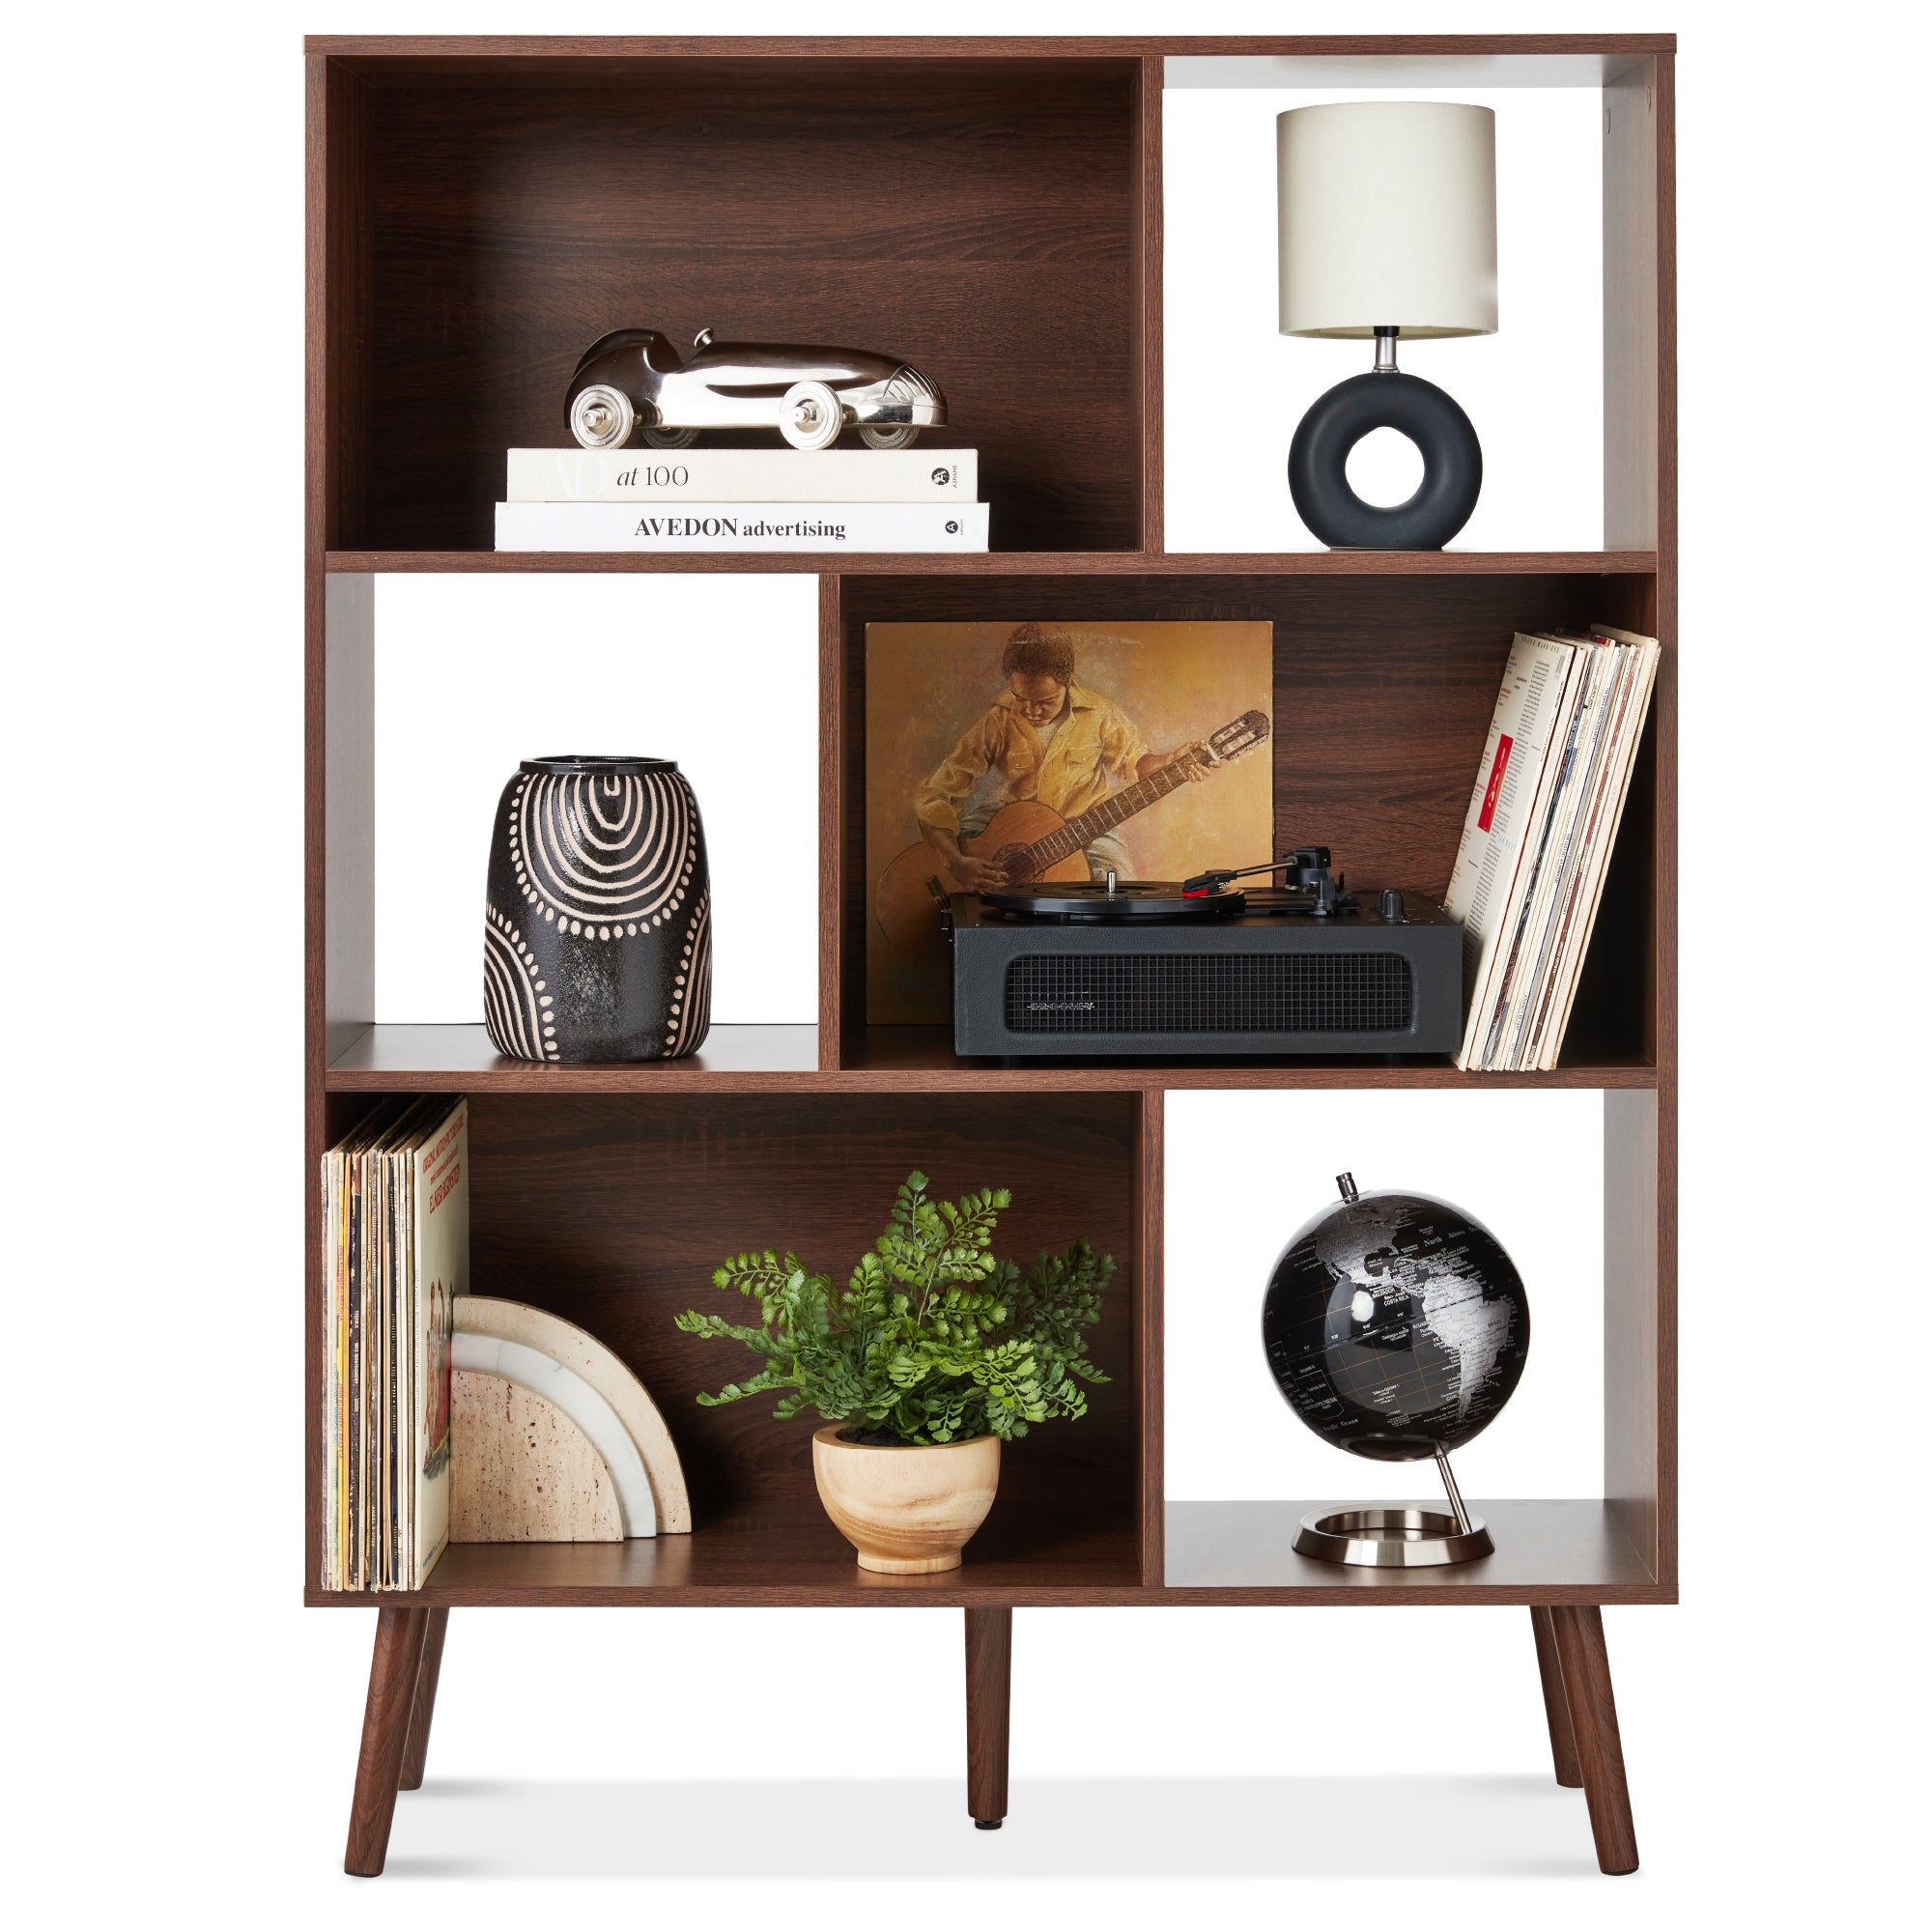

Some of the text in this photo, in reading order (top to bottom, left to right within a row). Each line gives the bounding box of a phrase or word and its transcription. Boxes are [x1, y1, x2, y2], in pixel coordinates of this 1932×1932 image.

[616, 467, 639, 487] at
[645, 466, 690, 487] 100
[634, 518, 847, 541] AVEDON advertising
[1423, 1236, 1443, 1247] North
